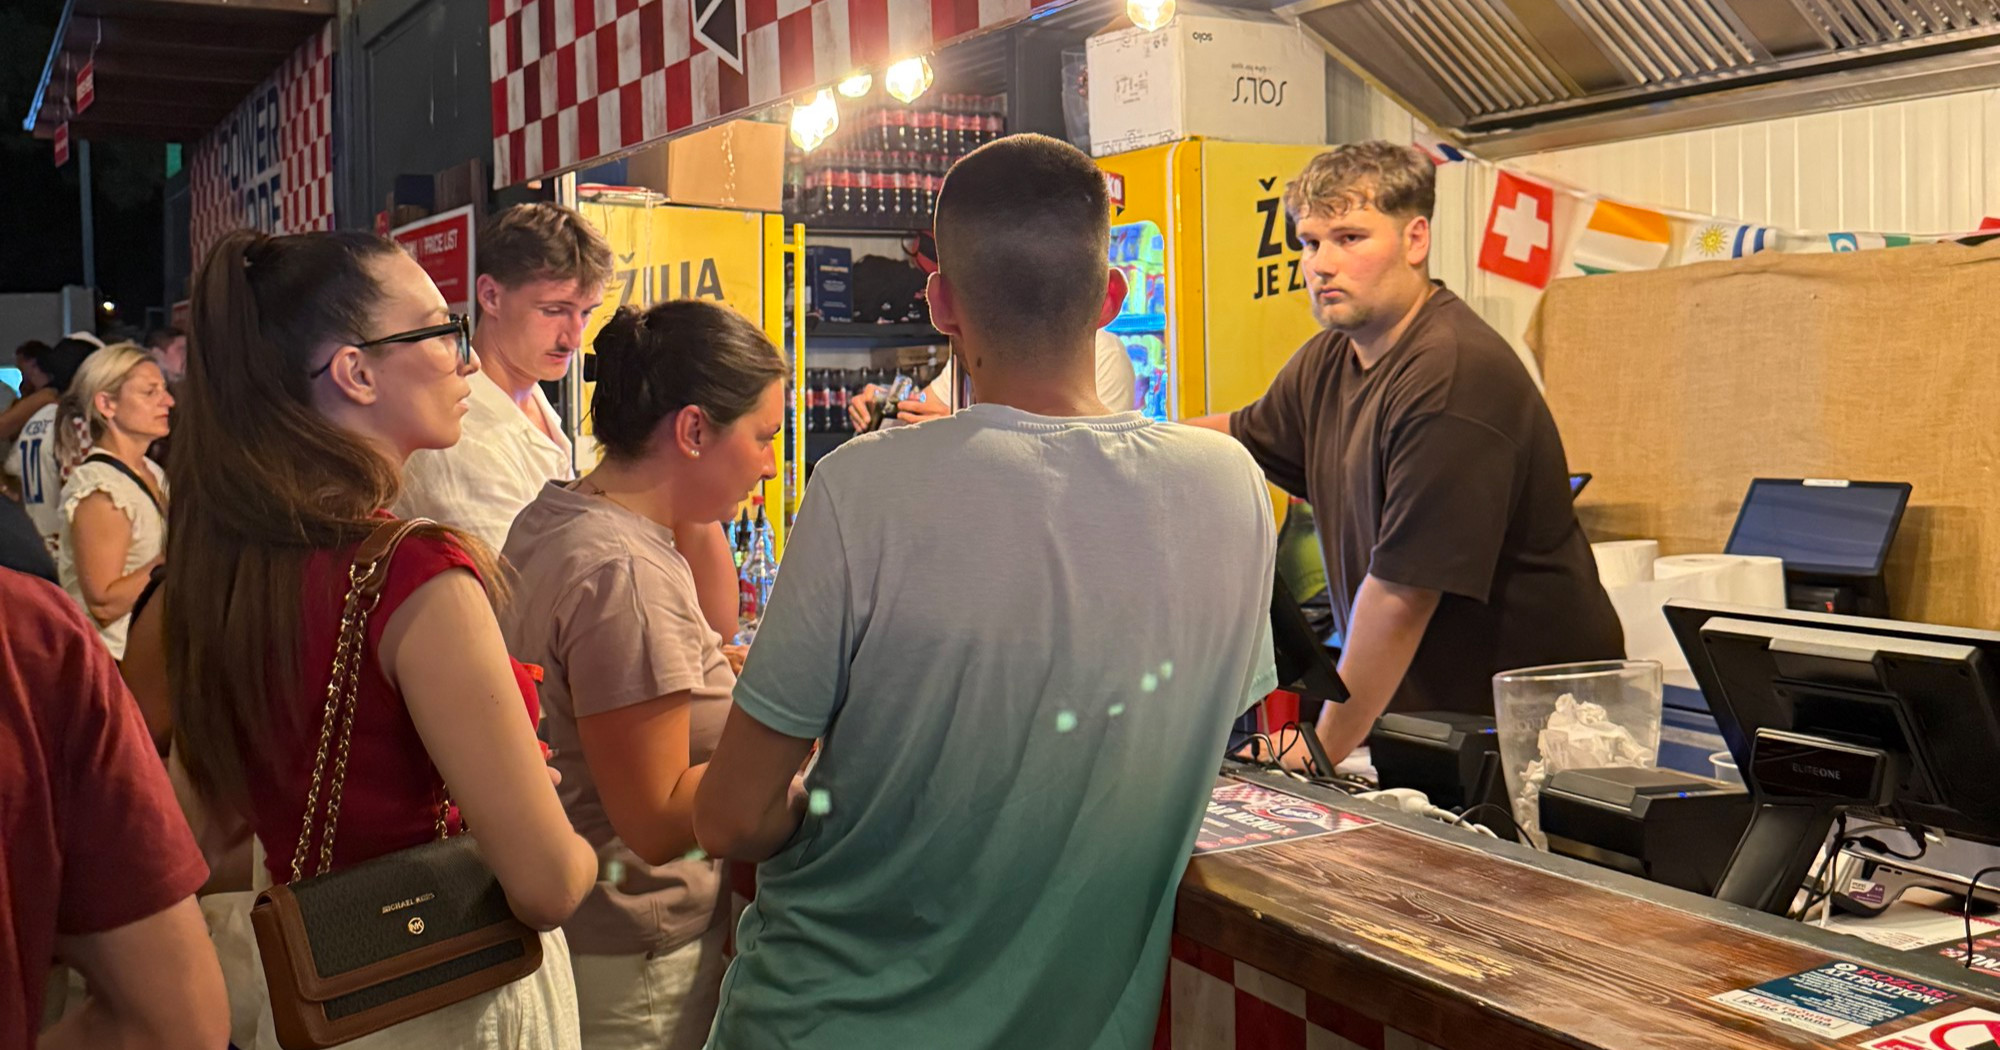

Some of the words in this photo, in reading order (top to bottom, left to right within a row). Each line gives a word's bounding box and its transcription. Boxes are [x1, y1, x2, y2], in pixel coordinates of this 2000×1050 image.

[221, 85, 281, 192] POWER
[245, 173, 282, 234] ODE
[424, 233, 444, 254] PRICE
[444, 229, 458, 250] LIST
[1253, 264, 1281, 300] JE
[1287, 258, 1307, 293] Z
[1792, 763, 1842, 781] ELITEONE
[382, 899, 414, 914] MICHAEL
[1817, 967, 1945, 1006] ATTENTION!
[1855, 968, 1958, 1000] POZOR!
